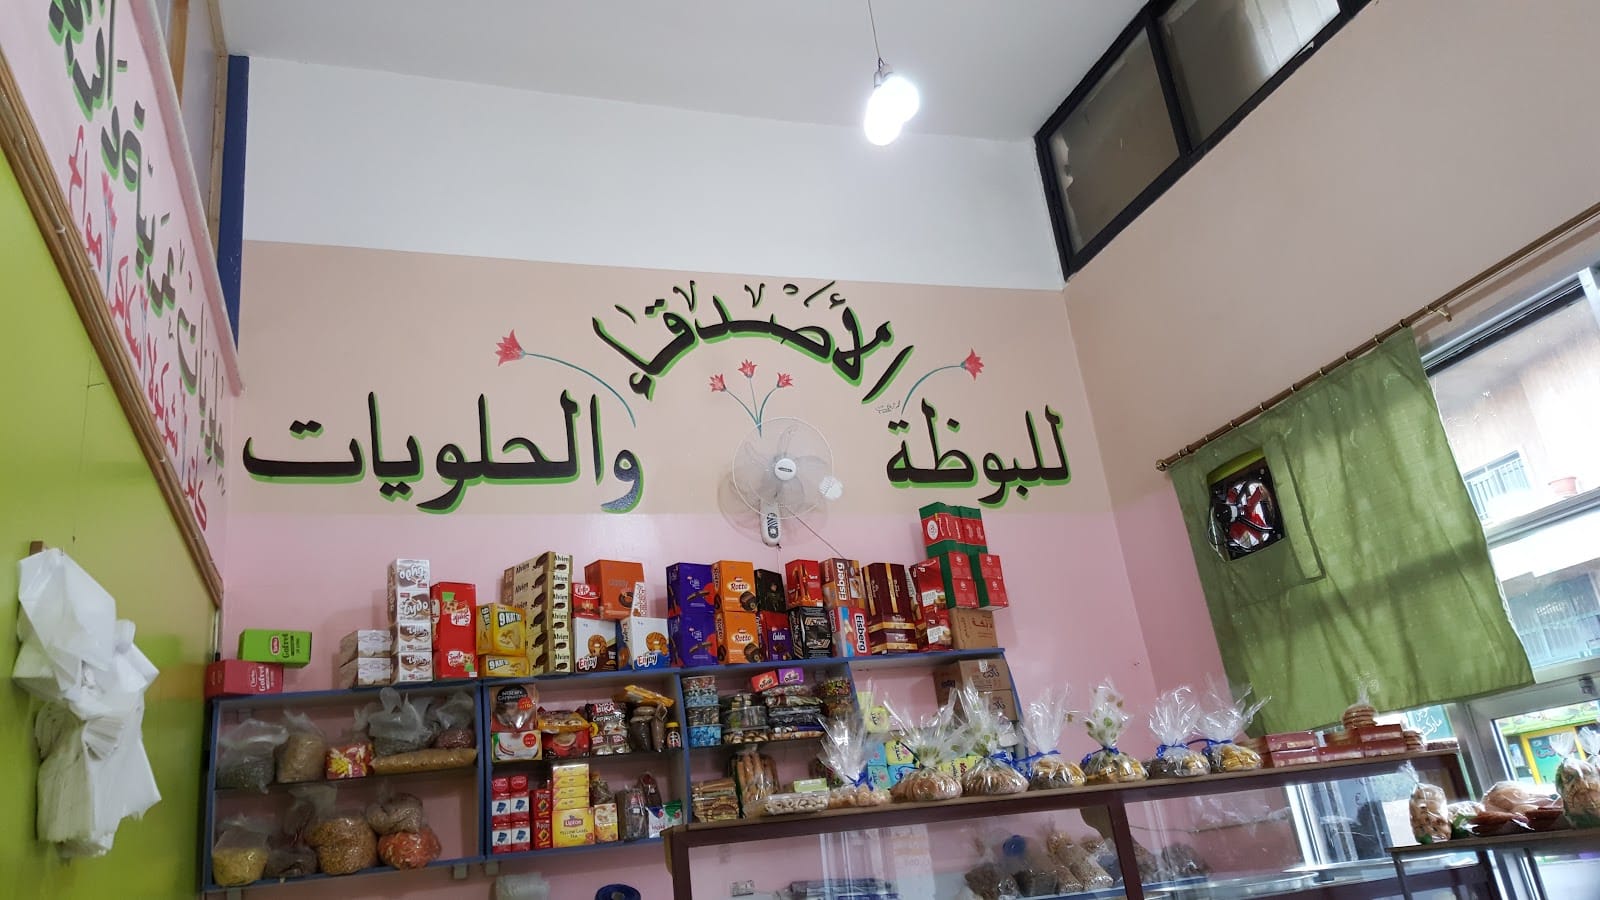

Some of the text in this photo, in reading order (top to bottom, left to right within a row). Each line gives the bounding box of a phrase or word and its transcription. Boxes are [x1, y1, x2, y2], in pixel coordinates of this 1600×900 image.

[591, 280, 914, 403] الأصدقاء
[243, 389, 644, 514] والحلويات
[886, 398, 1072, 509] للبوظة
[579, 656, 597, 670] Enjoy
[637, 653, 657, 667] Enjoy
[855, 613, 867, 653] Eisberg
